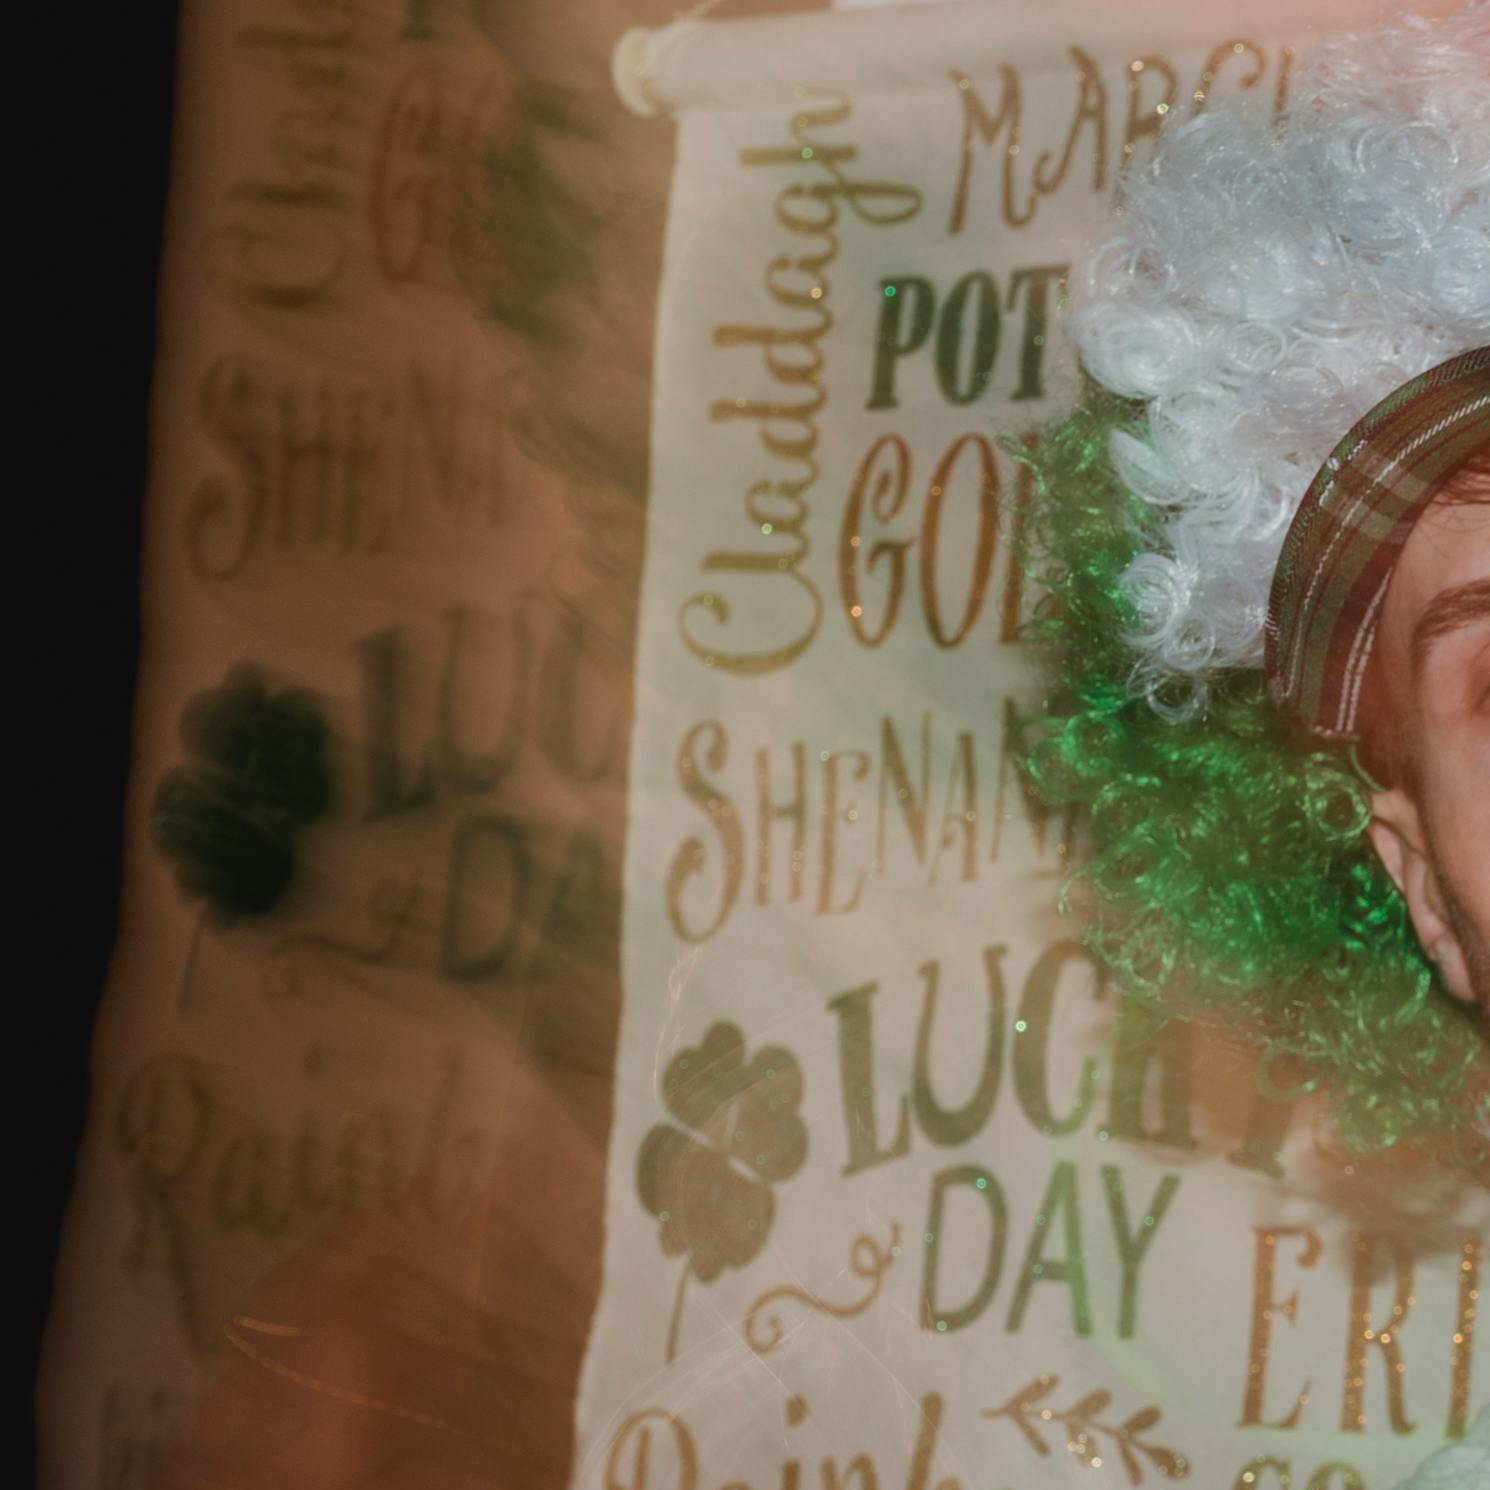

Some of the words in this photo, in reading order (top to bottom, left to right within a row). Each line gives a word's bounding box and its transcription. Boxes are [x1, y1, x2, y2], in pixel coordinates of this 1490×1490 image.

[677, 84, 923, 678] Claddagh
[865, 262, 1071, 413] POT
[917, 1158, 1181, 1341] DAY
